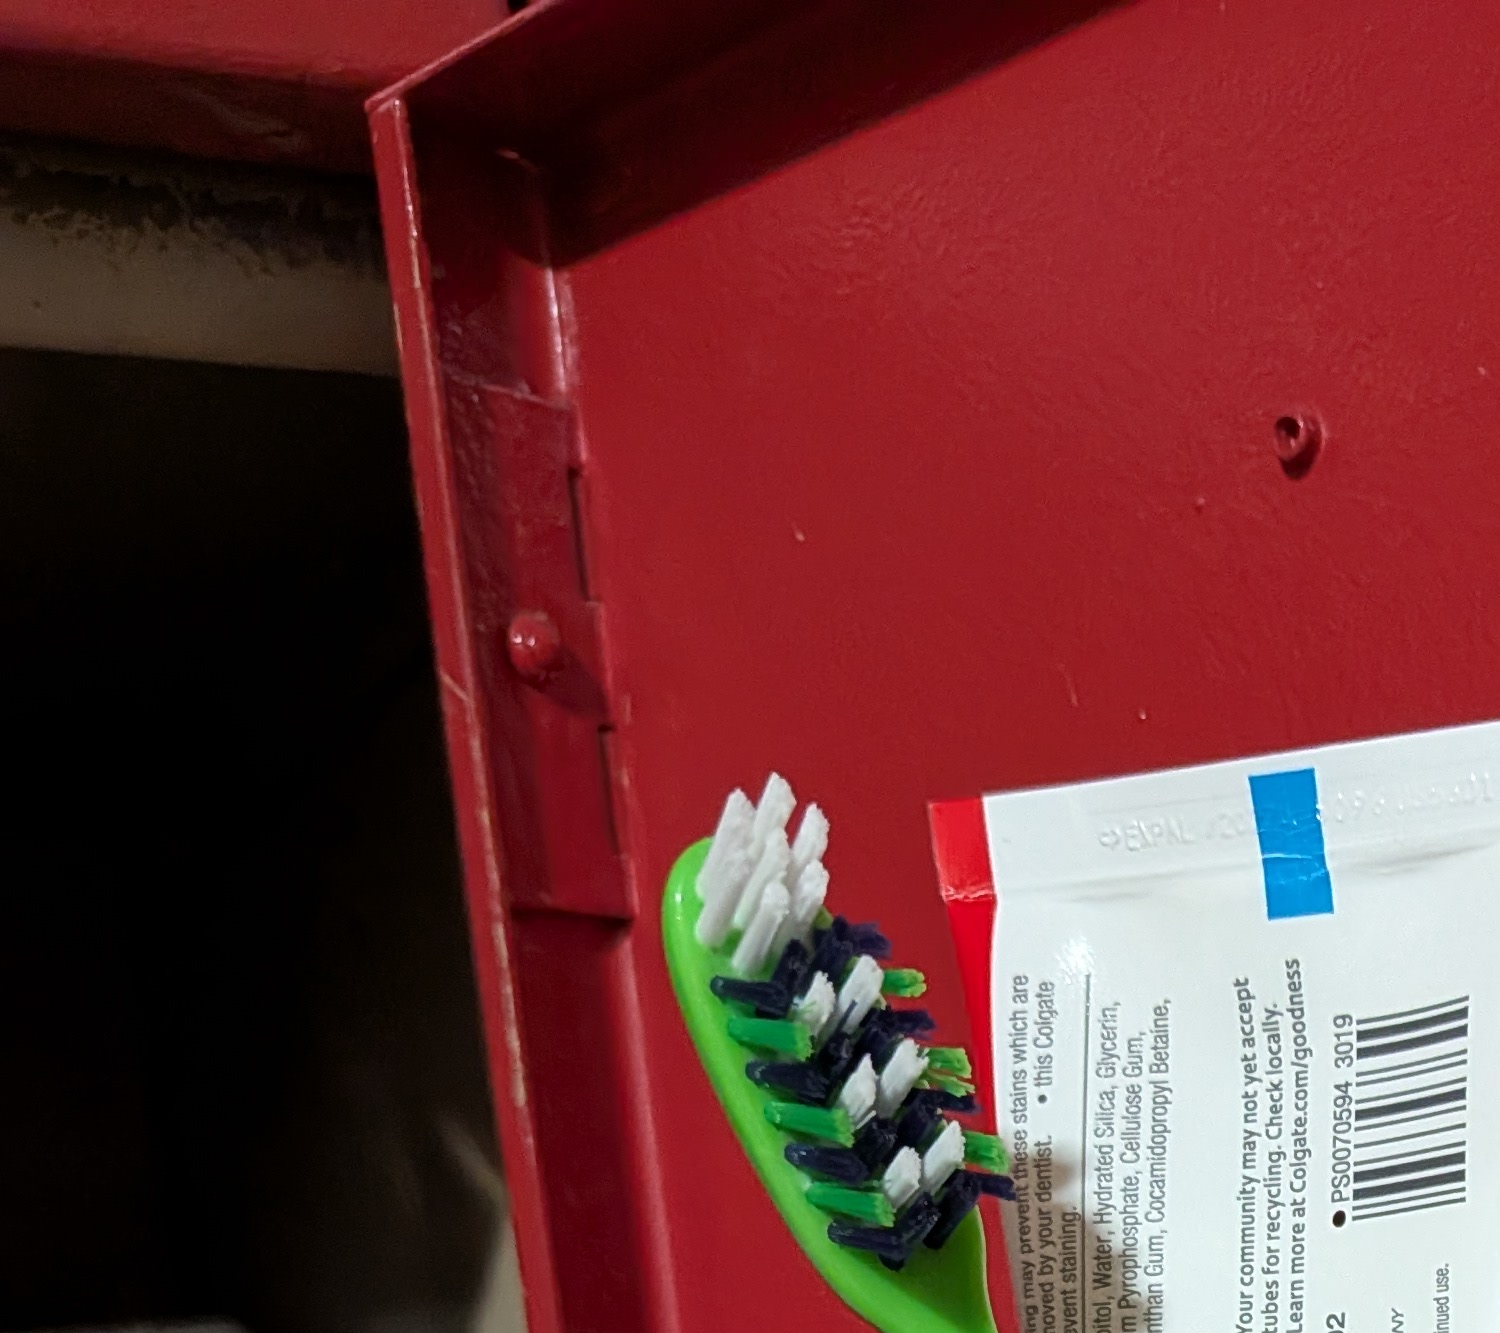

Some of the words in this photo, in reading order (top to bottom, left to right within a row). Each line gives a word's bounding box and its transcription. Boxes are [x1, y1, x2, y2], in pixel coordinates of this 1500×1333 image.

[1011, 975, 1028, 1004] are
[1034, 981, 1058, 1049] Colgate
[1232, 977, 1257, 1048] accept
[1008, 1008, 1028, 1065] which
[1095, 1001, 1120, 1079] Glycerin,
[1123, 1031, 1145, 1079] Gum,
[1147, 998, 1171, 1074] Betaine,
[1261, 1003, 1282, 1075] locally.
[1333, 1014, 1354, 1068] 3019
[1008, 1069, 1029, 1124] stains
[1033, 1054, 1052, 1087] this
[1239, 1053, 1263, 1086] yet
[1284, 959, 1313, 1193] Colgate.com/goodness
[1093, 1085, 1117, 1139] Silica,
[1121, 1085, 1142, 1164] Cellulose
[1238, 1092, 1258, 1124] not
[1264, 1080, 1284, 1140] Check
[1010, 1129, 1029, 1180] these
[1034, 1135, 1053, 1203] dentist.
[1144, 1081, 1172, 1223] Cocamidopropyl
[1242, 1129, 1261, 1169] may
[1330, 1081, 1353, 1203] PS0070594
[1092, 1144, 1115, 1225] Hydrated
[1263, 1145, 1286, 1241] recycling.
[1290, 1197, 1307, 1218] at
[1013, 1185, 1036, 1254] prevent
[1037, 1207, 1057, 1249] your
[1055, 1206, 1080, 1283] staining.
[1118, 1170, 1142, 1309] Pyrophosphate,
[1236, 1176, 1262, 1287] community
[1037, 1254, 1057, 1276] by
[1093, 1231, 1113, 1289] Water,
[1143, 1229, 1166, 1277] Gum,
[1261, 1246, 1280, 1275] for
[1290, 1224, 1306, 1274] more
[1434, 1262, 1451, 1293] use.
[1020, 1261, 1037, 1299] may
